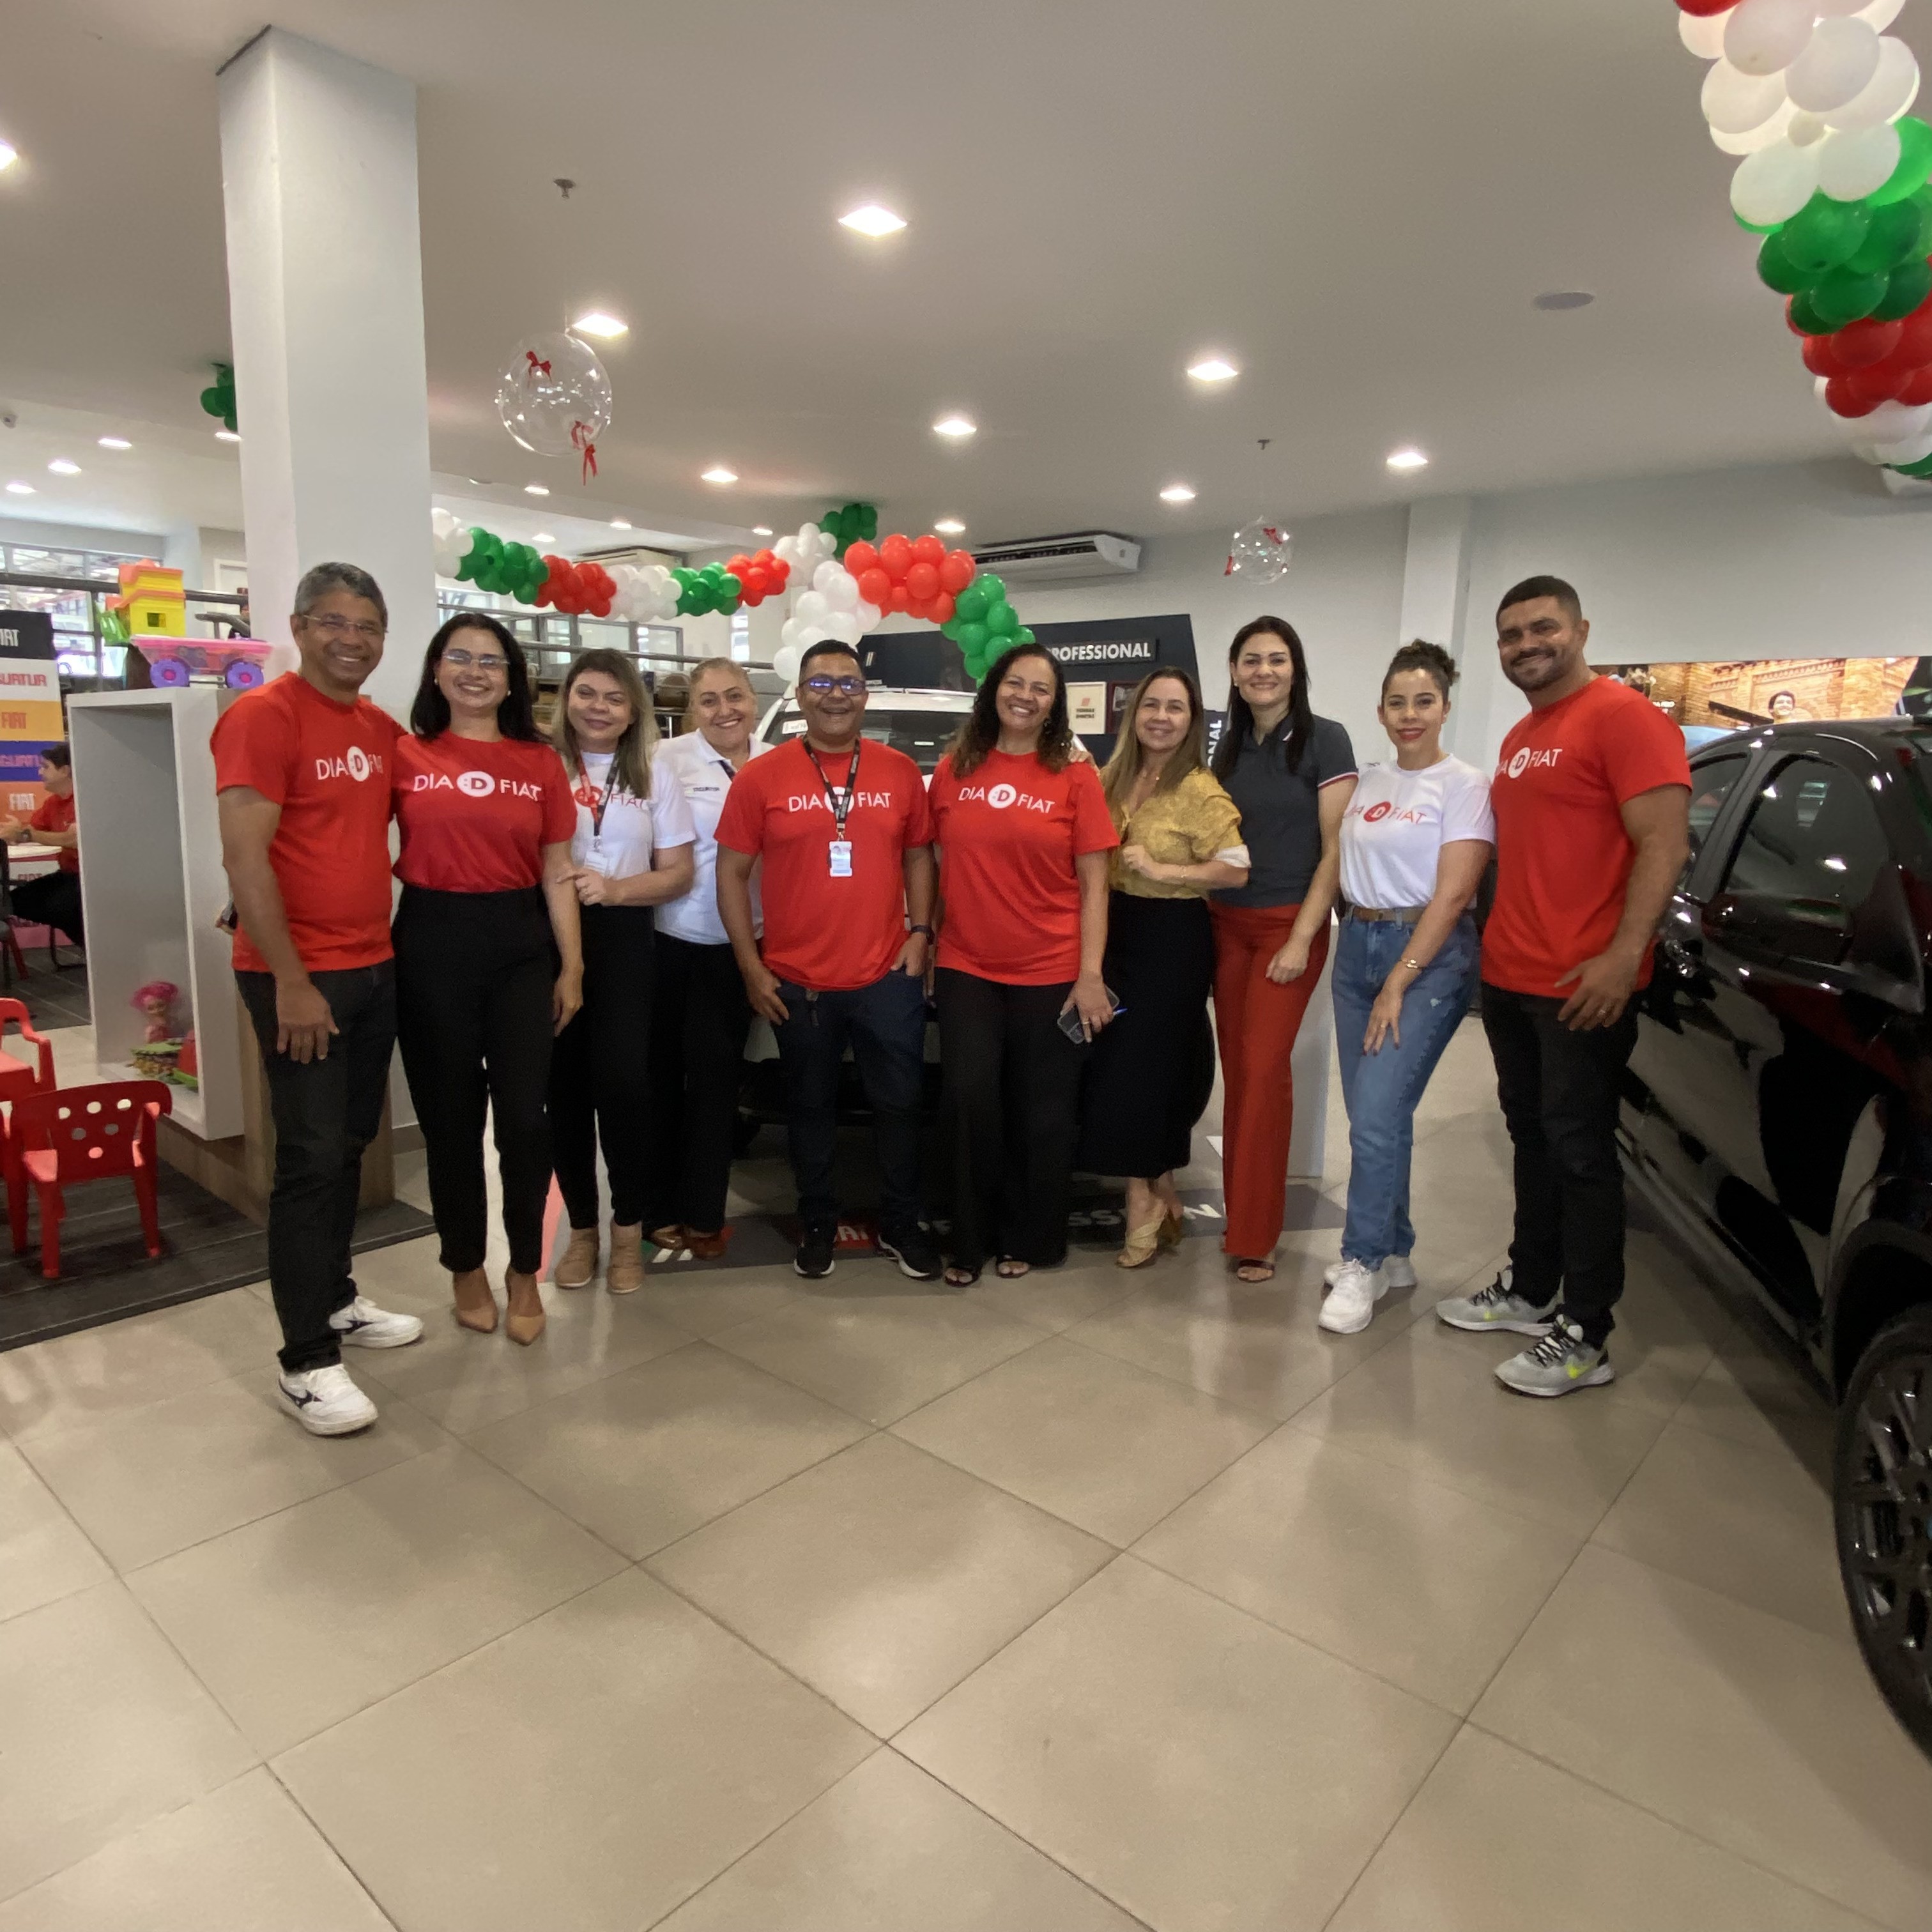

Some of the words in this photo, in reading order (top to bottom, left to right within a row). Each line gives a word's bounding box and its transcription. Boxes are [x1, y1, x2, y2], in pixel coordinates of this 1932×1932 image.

[0, 629, 19, 647] IAT
[1045, 643, 1151, 661] ROFESSIONAL
[316, 756, 349, 780] DIA
[1528, 749, 1563, 769] FIAT
[413, 773, 454, 792] DIA
[500, 779, 542, 801] FIAT
[788, 793, 824, 812] DIA
[857, 792, 891, 808] FIAT
[958, 786, 985, 801] DIA
[1017, 793, 1055, 813] FIAT
[1388, 807, 1427, 824] FIAT
